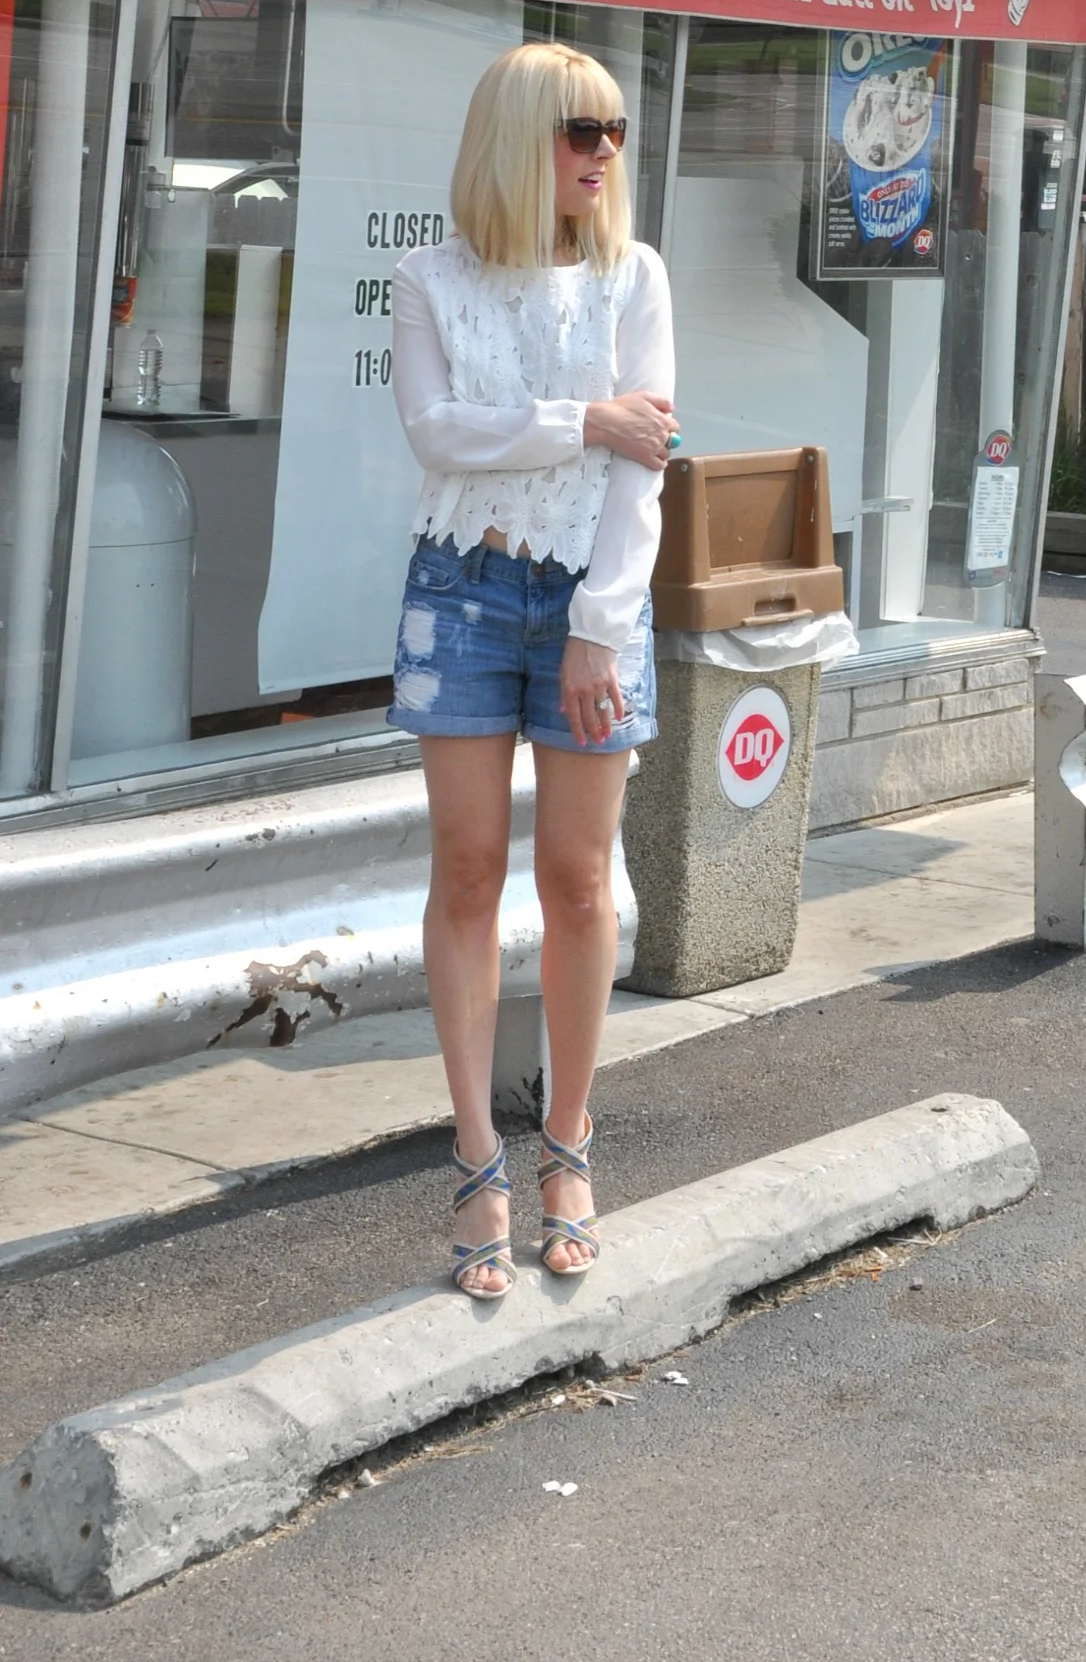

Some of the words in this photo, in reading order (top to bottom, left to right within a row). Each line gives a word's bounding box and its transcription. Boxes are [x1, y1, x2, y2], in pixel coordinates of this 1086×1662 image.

[367, 212, 445, 249] CLOSED
[990, 442, 1007, 458] DQ
[734, 728, 775, 767] DQ
